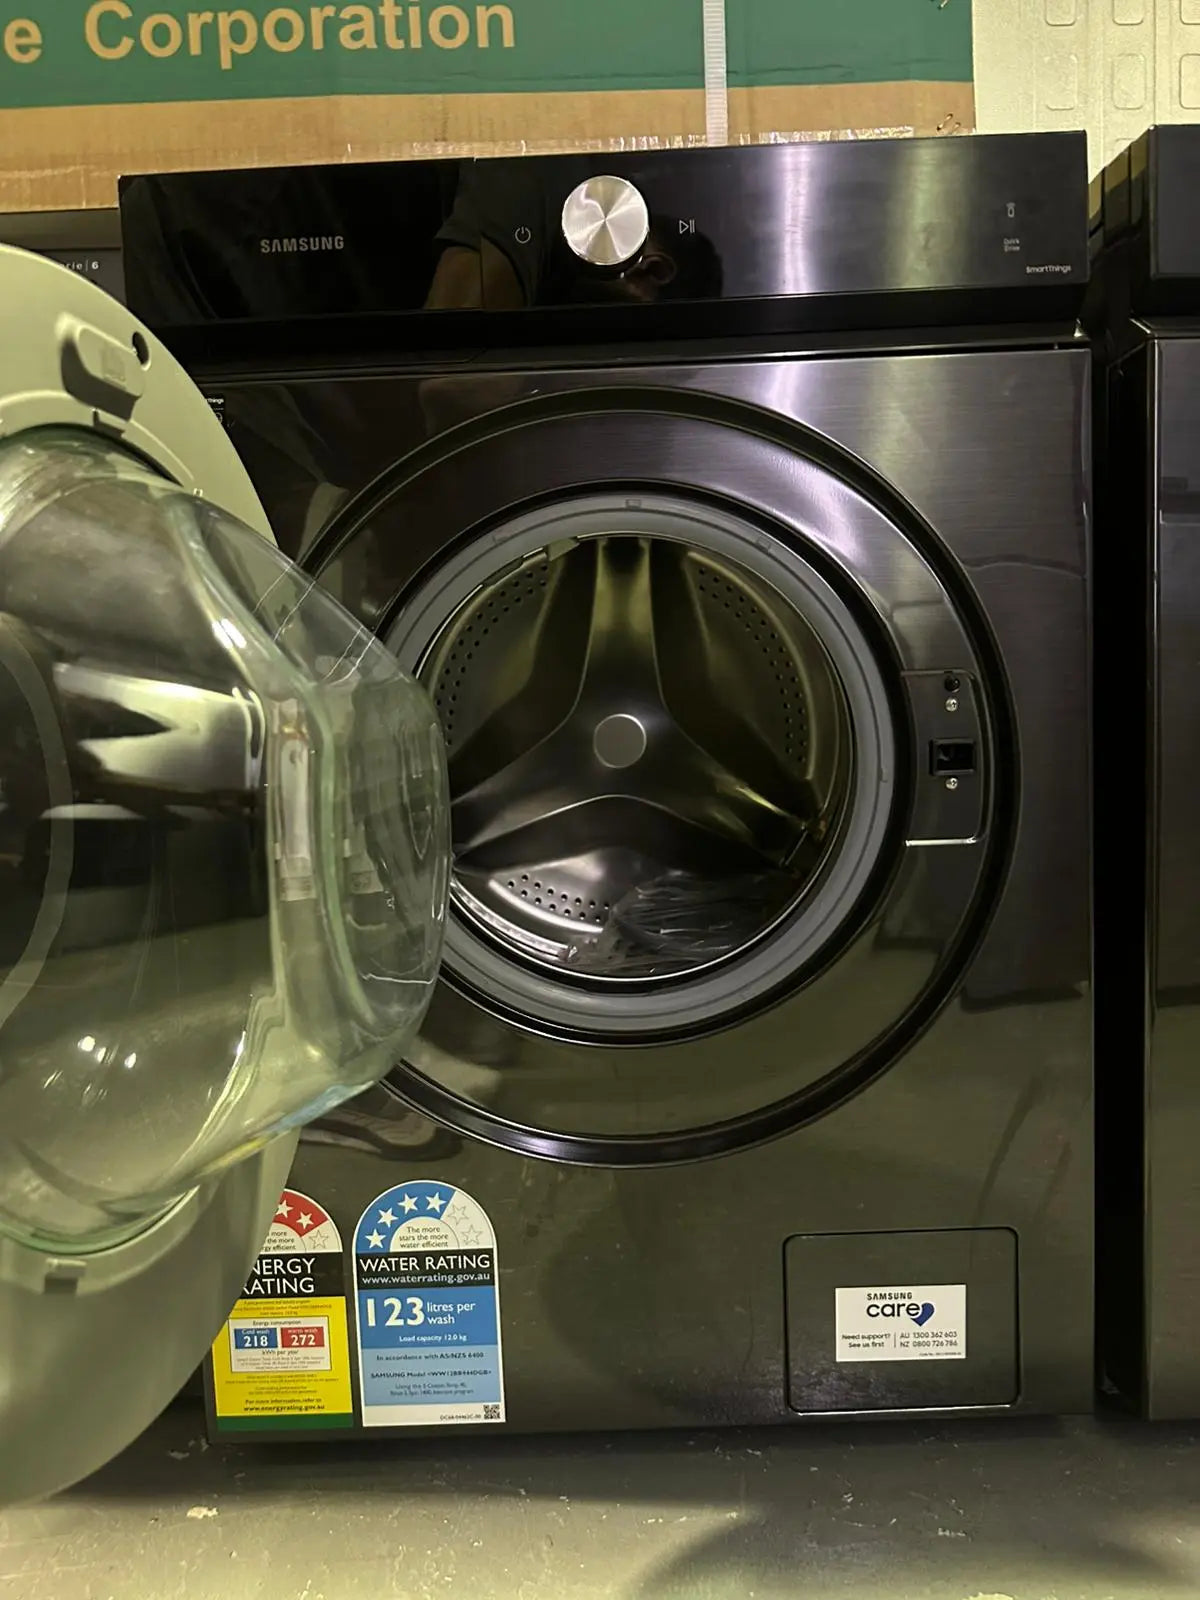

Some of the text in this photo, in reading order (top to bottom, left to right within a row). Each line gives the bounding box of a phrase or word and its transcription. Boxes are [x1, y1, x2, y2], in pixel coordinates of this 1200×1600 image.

[3, 0, 515, 69] e Corporation
[260, 235, 344, 253] SAMSUNG
[91, 261, 99, 270] 6
[422, 1240, 448, 1248] efficient
[359, 1254, 490, 1272] WATER RATING
[362, 1273, 490, 1284] www.waterrating.gov.au
[867, 1292, 912, 1300] SAMSUNG
[366, 1296, 476, 1326] 123 litres per
[866, 1303, 921, 1317] care
[427, 1314, 455, 1325] wash
[243, 1335, 268, 1347] 218
[291, 1334, 316, 1346] 272
[861, 1333, 891, 1341] support?
[244, 1404, 325, 1412] www.energyrating.gov.au
